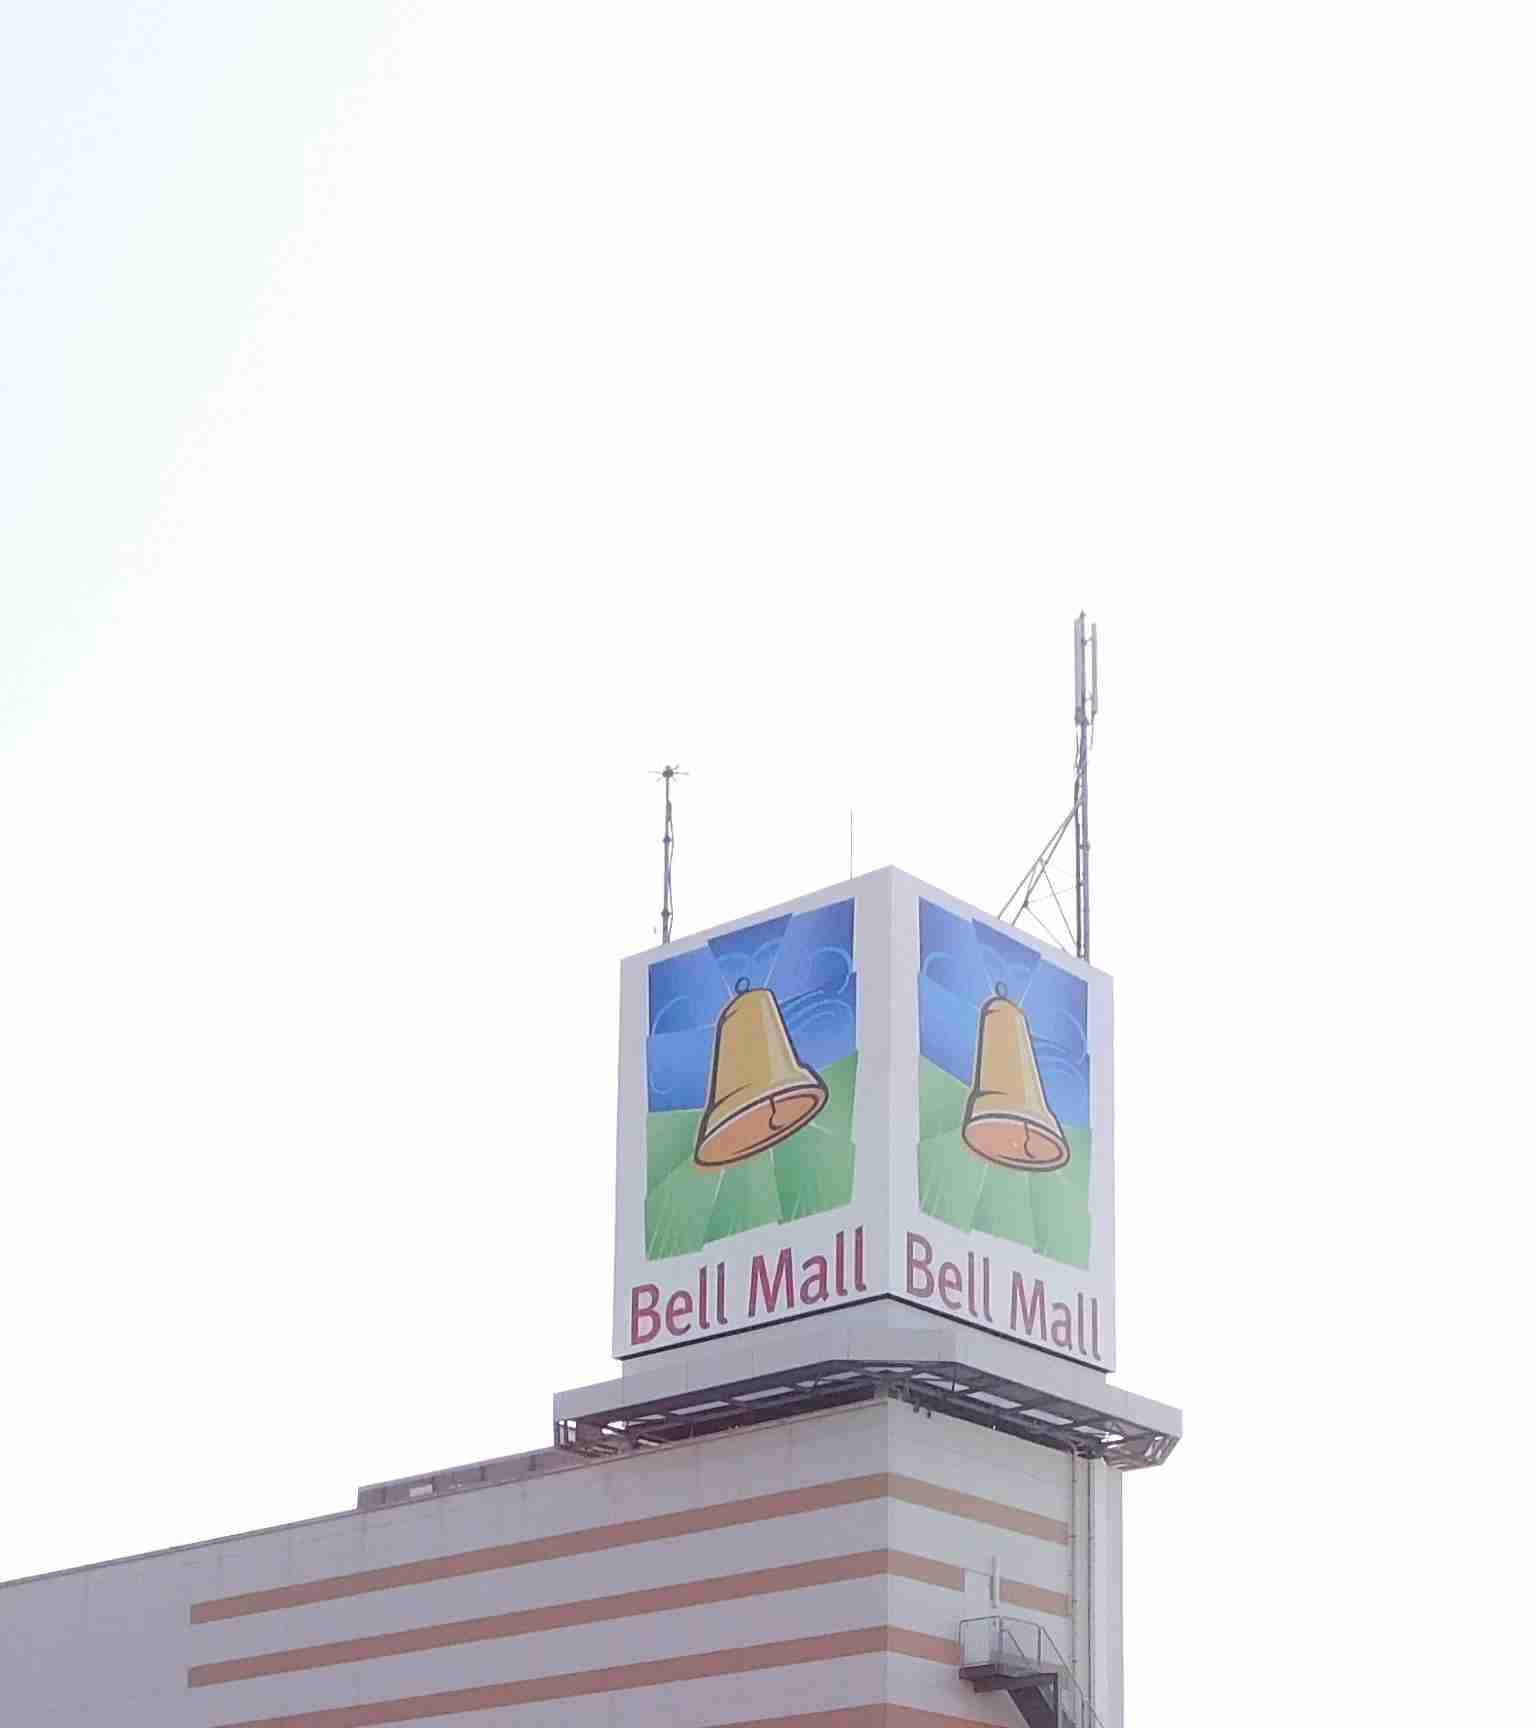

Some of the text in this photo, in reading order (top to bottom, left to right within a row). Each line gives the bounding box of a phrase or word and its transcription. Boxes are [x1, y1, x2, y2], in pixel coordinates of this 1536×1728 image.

[630, 1226, 867, 1345] Bell Mall
[906, 1231, 1102, 1362] Bell Mall
